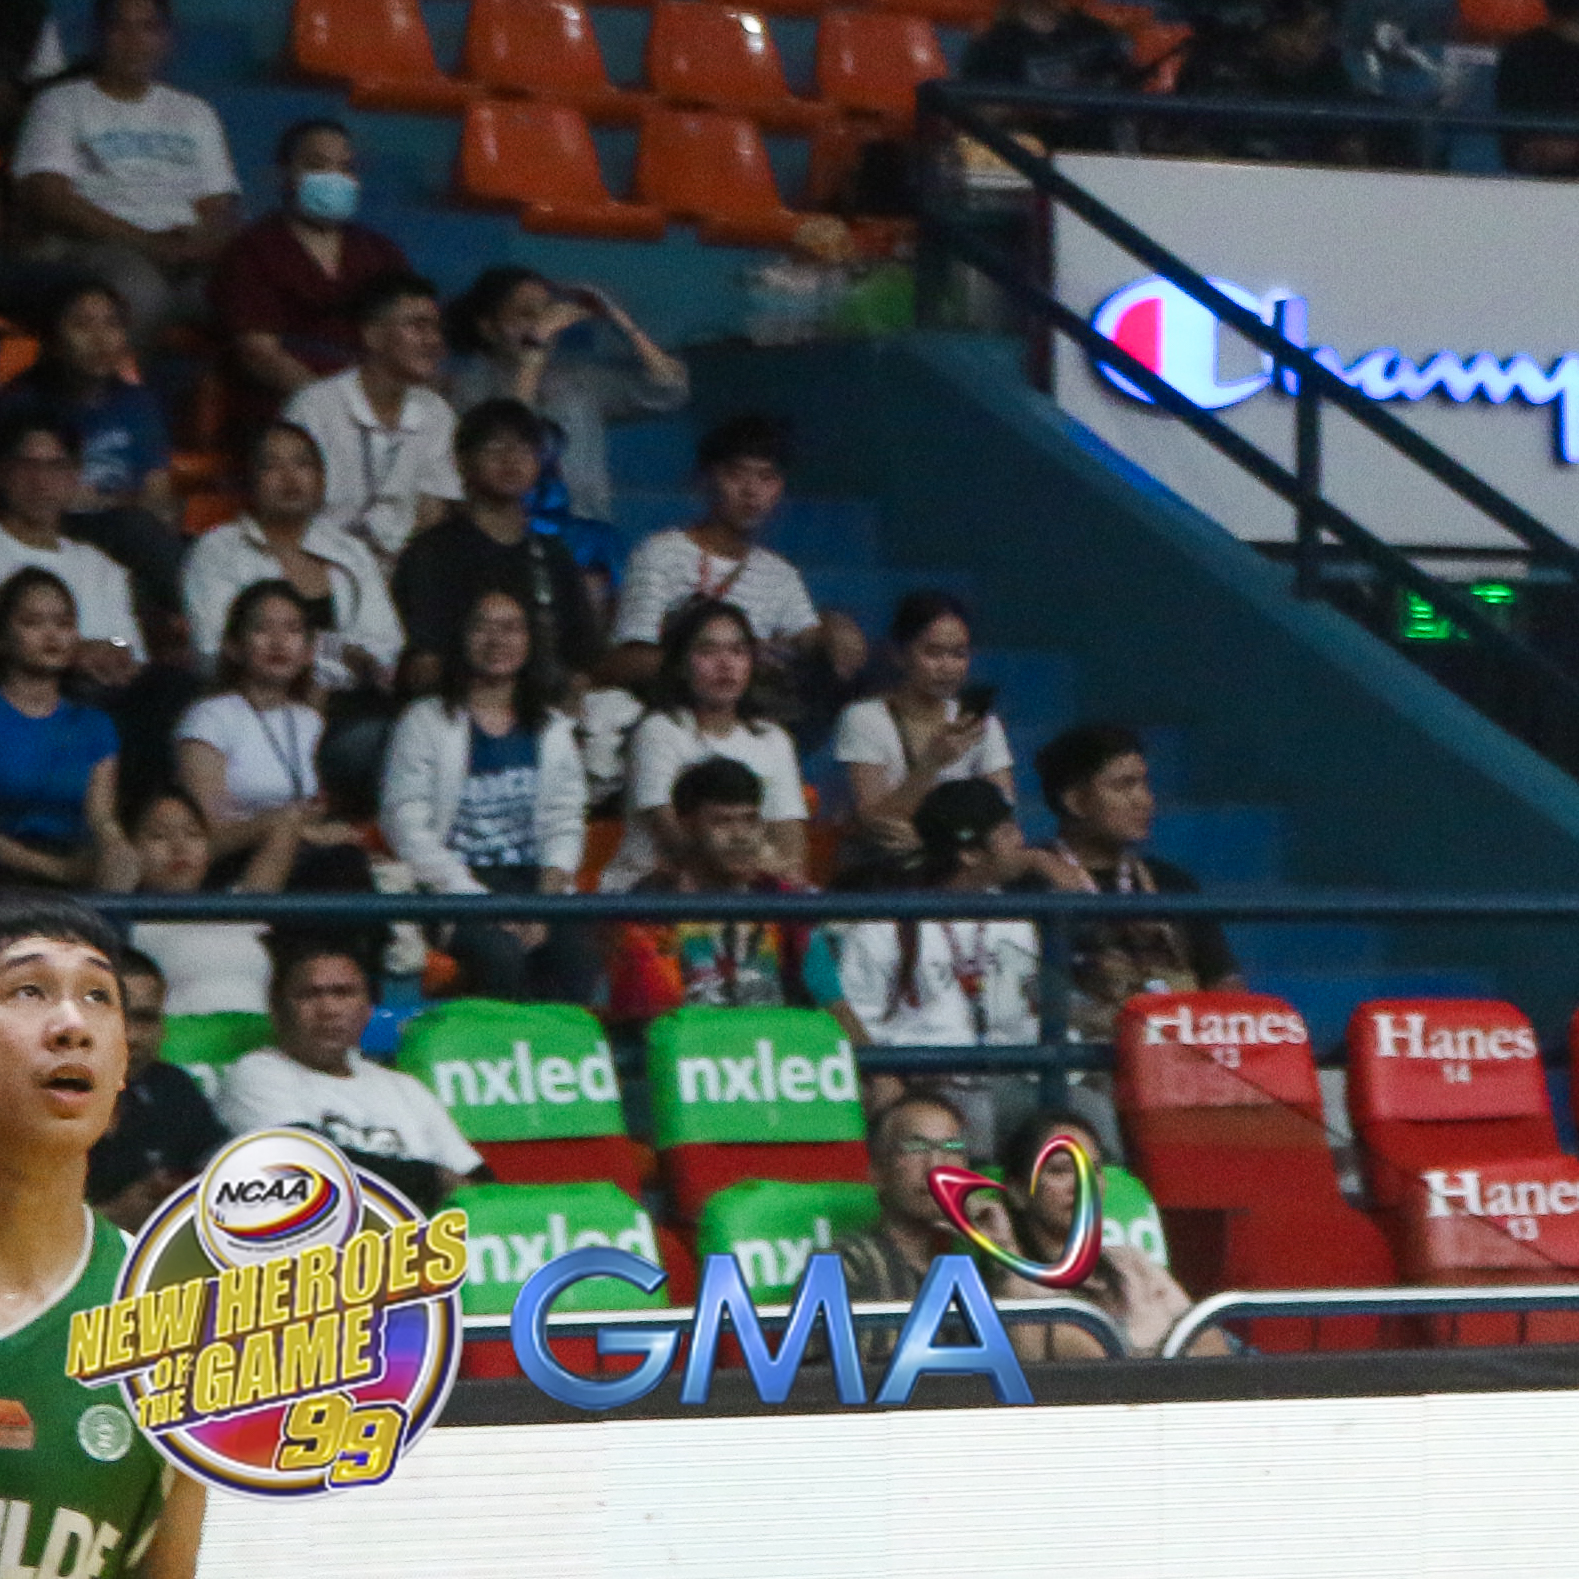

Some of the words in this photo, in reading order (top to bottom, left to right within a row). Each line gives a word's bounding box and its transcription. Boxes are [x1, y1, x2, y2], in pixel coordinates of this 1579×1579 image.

[1145, 1006, 1309, 1046] Hanes
[1373, 1012, 1538, 1060] Hanes
[435, 1039, 618, 1108] nxled
[678, 1037, 859, 1106] nxled
